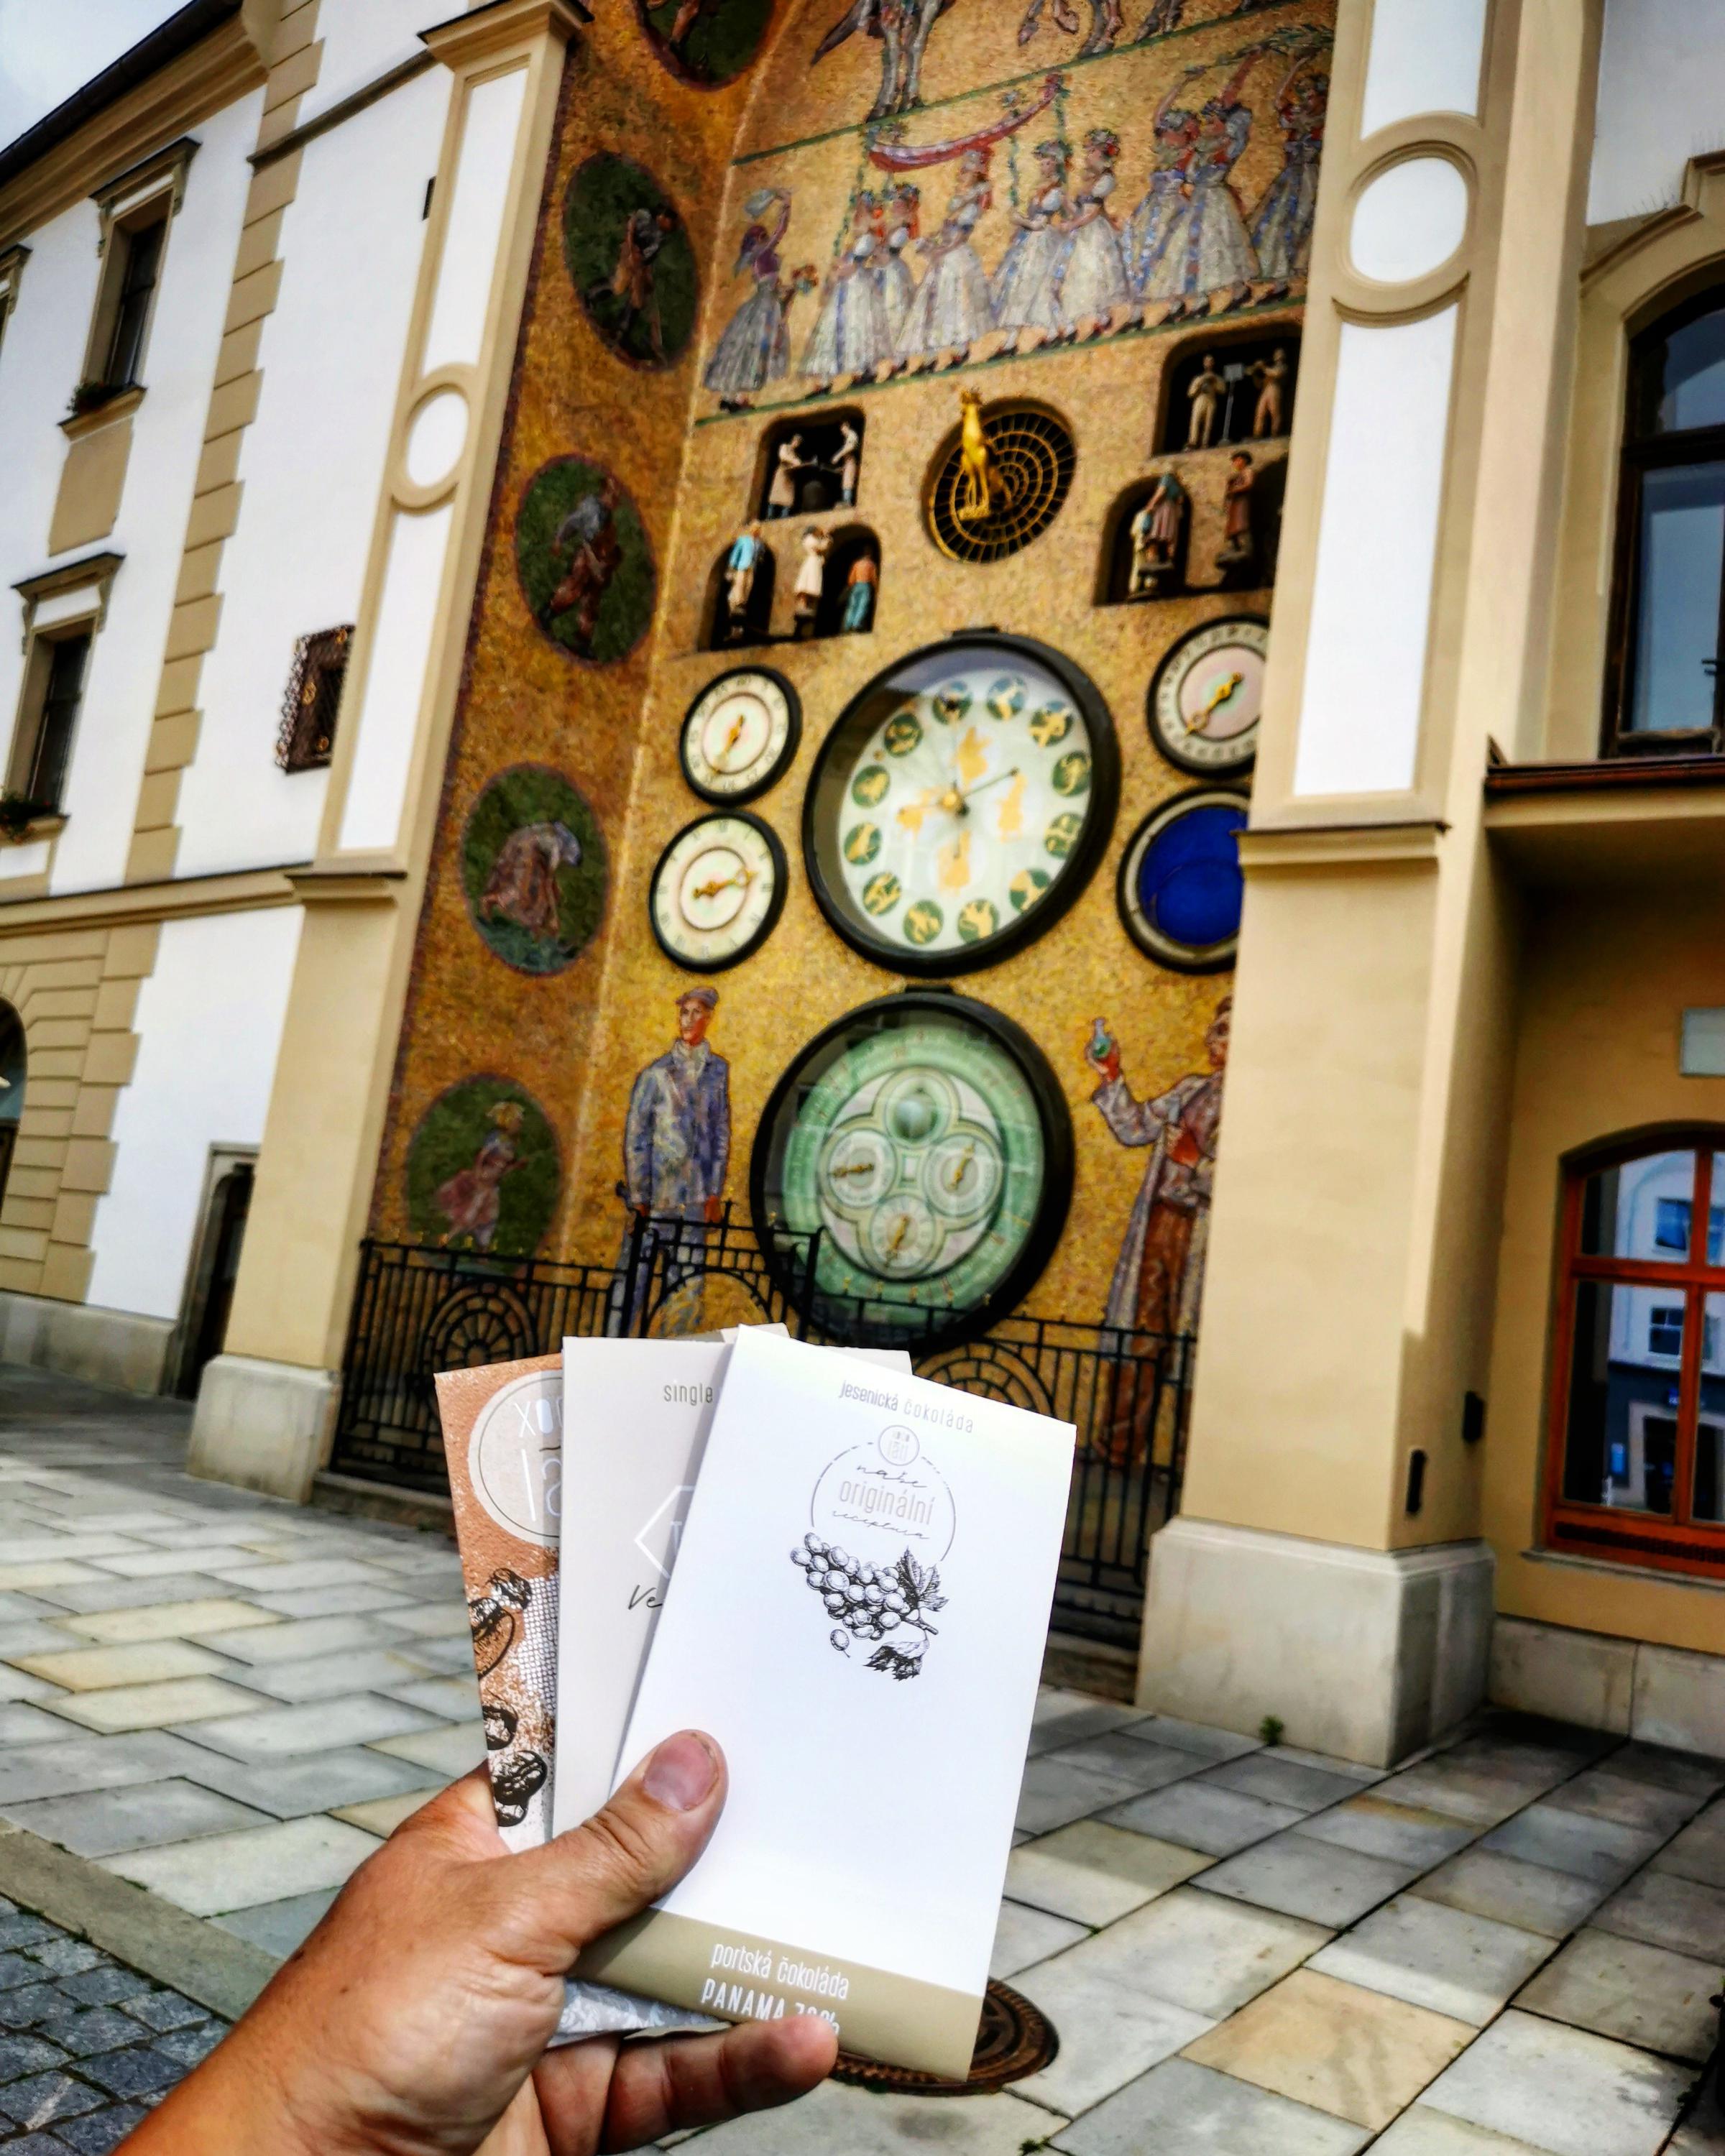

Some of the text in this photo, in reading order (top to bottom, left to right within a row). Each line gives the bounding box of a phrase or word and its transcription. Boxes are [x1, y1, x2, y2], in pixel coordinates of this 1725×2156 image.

[664, 1381, 713, 1406] single
[839, 1380, 973, 1433] jesenická čokoláda
[840, 1480, 936, 1525] originální
[832, 1510, 930, 1539] receptura
[627, 1585, 663, 1611] Ve
[710, 1943, 850, 2000] portská čokoláda
[701, 1978, 786, 2020] PANAMA
